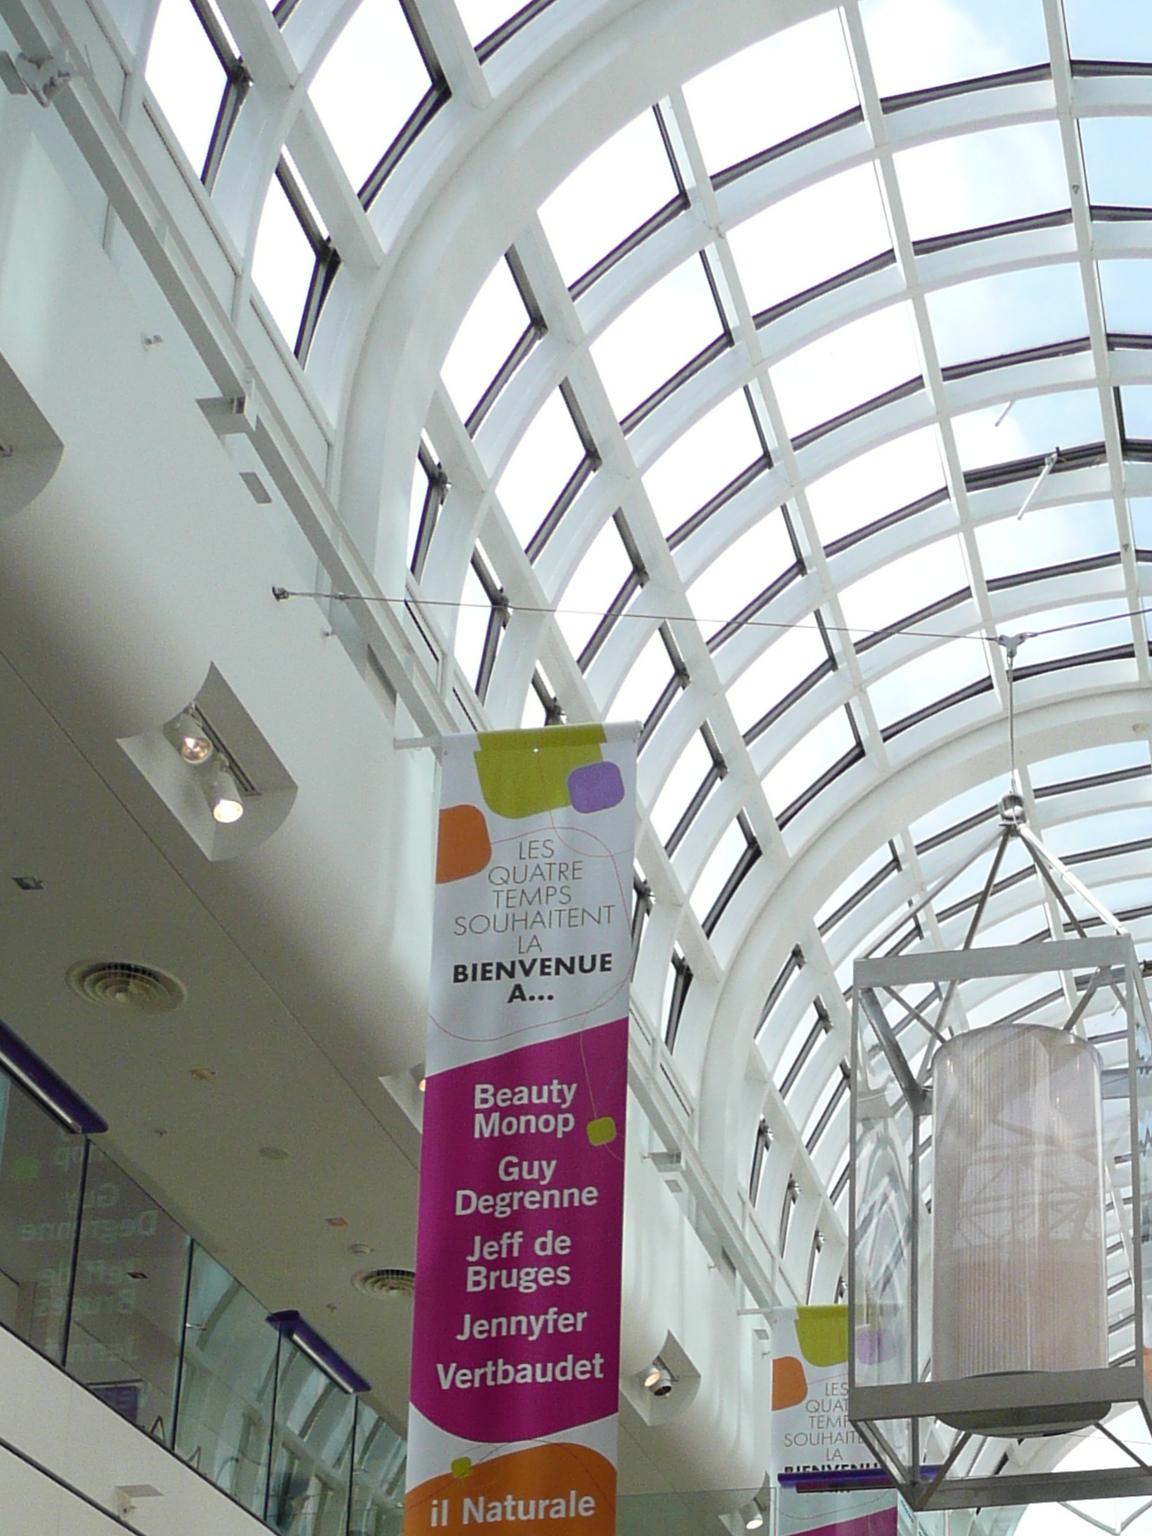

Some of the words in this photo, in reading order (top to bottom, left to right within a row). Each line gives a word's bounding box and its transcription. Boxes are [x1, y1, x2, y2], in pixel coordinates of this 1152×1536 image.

[518, 839, 555, 861] LES
[488, 860, 583, 886] QUATRE
[492, 885, 573, 909] TEMPS
[453, 904, 617, 937] SOUHAITENT
[517, 933, 544, 955] LA
[452, 953, 614, 984] BIENVENUE
[507, 982, 555, 1004] A...
[474, 1080, 577, 1111] Beauty
[473, 1111, 576, 1140] Monop
[498, 1156, 558, 1185] Guy
[455, 1185, 600, 1218] Degrenne
[466, 1231, 522, 1262] Jeff
[534, 1230, 572, 1257] de
[466, 1262, 572, 1293] Bruges
[456, 1309, 588, 1342] Jennyfer
[436, 1352, 605, 1390] Vertbaudet
[825, 1448, 843, 1461] LA
[430, 1500, 449, 1528] il
[461, 1490, 597, 1524] Naturale
